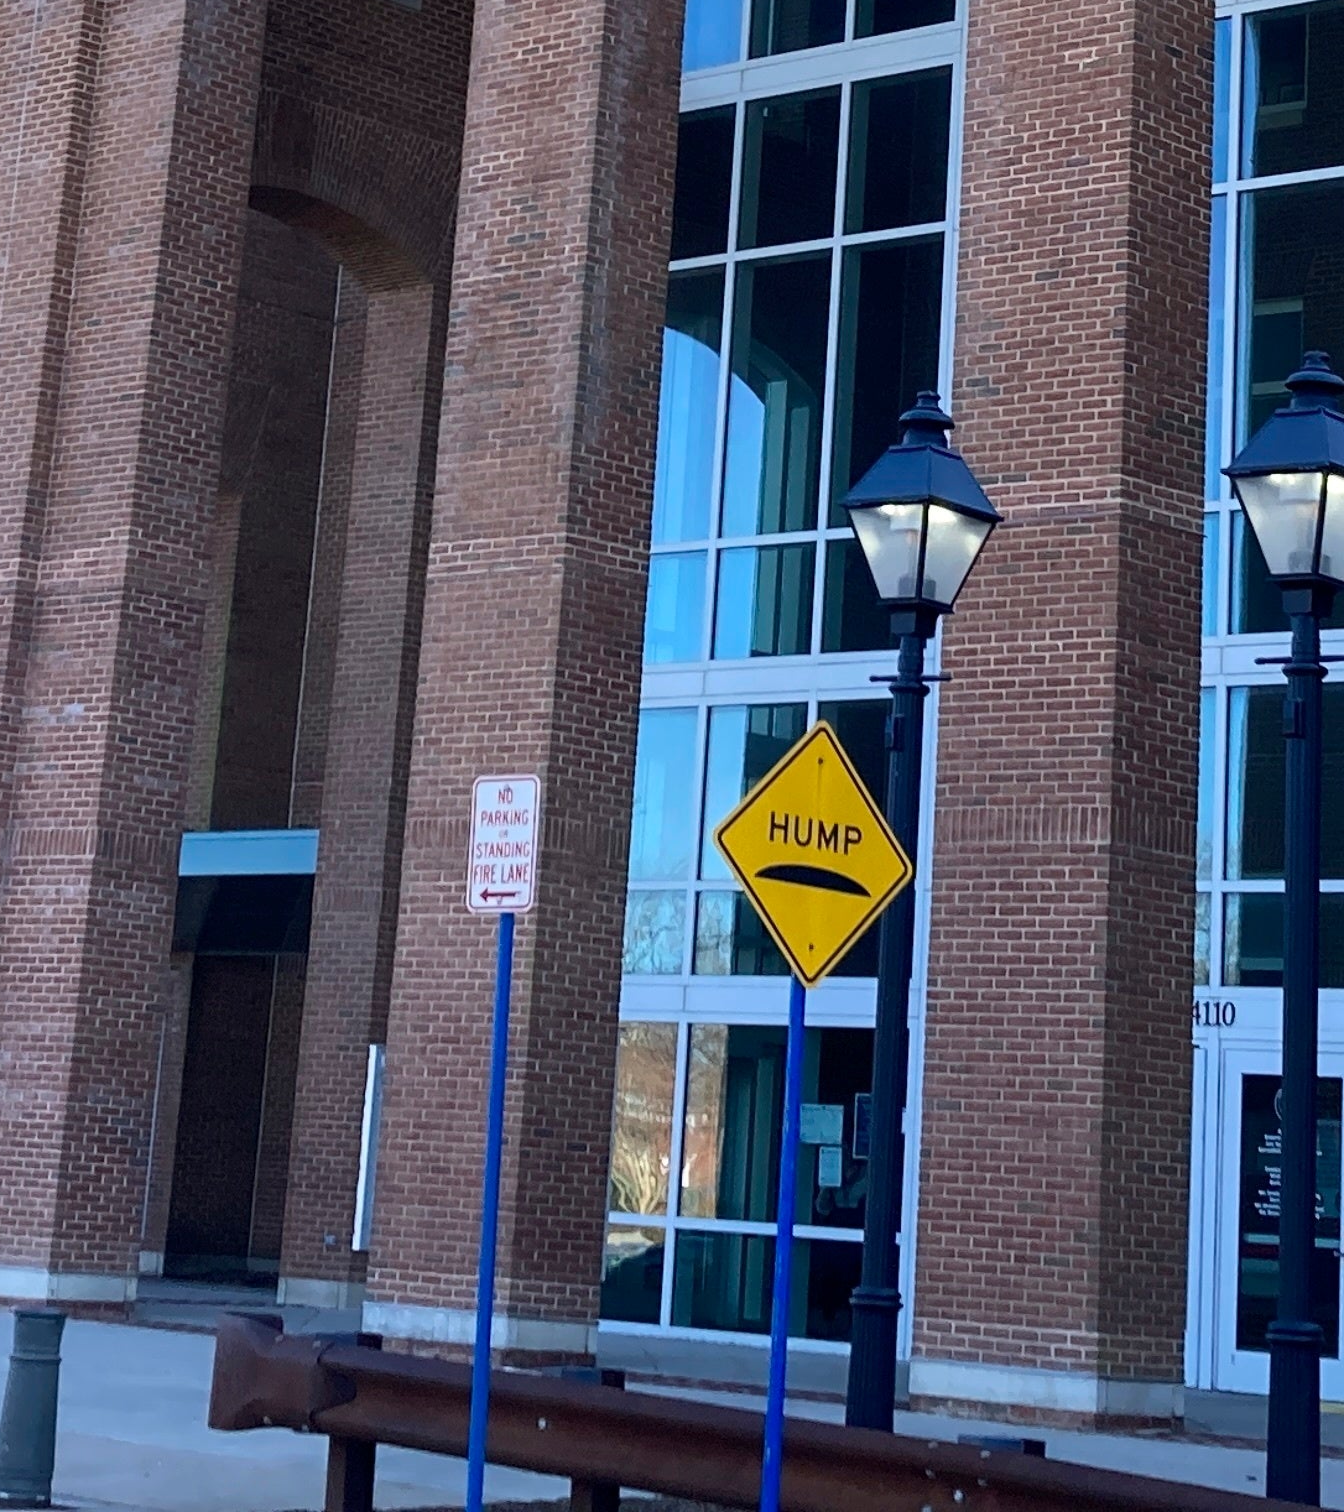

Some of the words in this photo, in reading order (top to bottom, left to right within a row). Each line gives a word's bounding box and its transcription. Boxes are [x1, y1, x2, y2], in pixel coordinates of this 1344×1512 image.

[498, 787, 513, 804] NO
[480, 809, 529, 827] PARKING
[769, 811, 862, 855] HUMP
[476, 841, 530, 859] STANDING
[473, 864, 497, 884] FIRE
[500, 863, 529, 884] LANE
[1191, 1000, 1236, 1027] 4110
